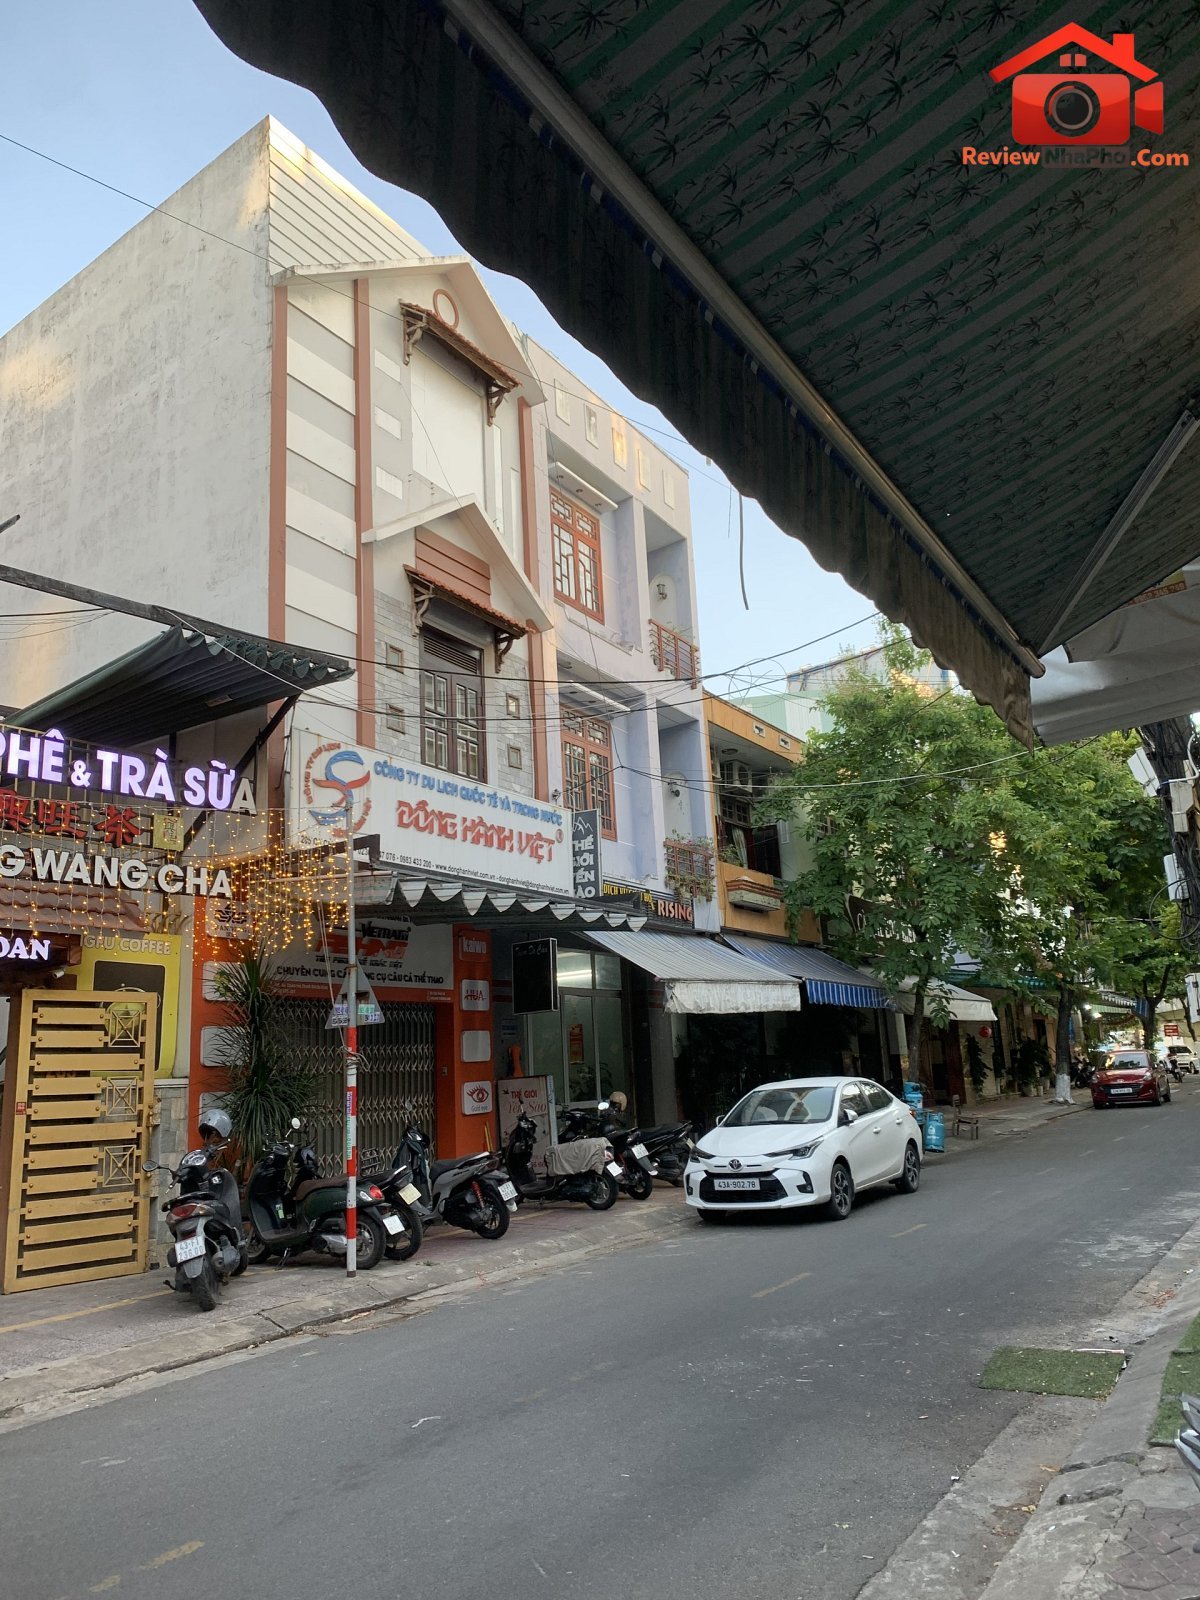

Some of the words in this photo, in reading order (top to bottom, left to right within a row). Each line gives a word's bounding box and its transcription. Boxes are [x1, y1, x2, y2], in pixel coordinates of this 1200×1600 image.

[71, 760, 91, 787] &
[97, 748, 175, 802] TRÀ
[184, 760, 257, 815] SỮA
[374, 760, 405, 781] CÔNG
[406, 770, 420, 785] TY
[421, 774, 435, 790] DU
[33, 848, 149, 889] WANG
[158, 864, 232, 899] CHA
[657, 900, 693, 923] RISING
[120, 938, 172, 955] COFFEE
[277, 964, 312, 977] CHUYÊN
[313, 968, 336, 978] CUNG
[428, 976, 444, 984] THAO
[717, 1180, 757, 1189] 43A-902.78
